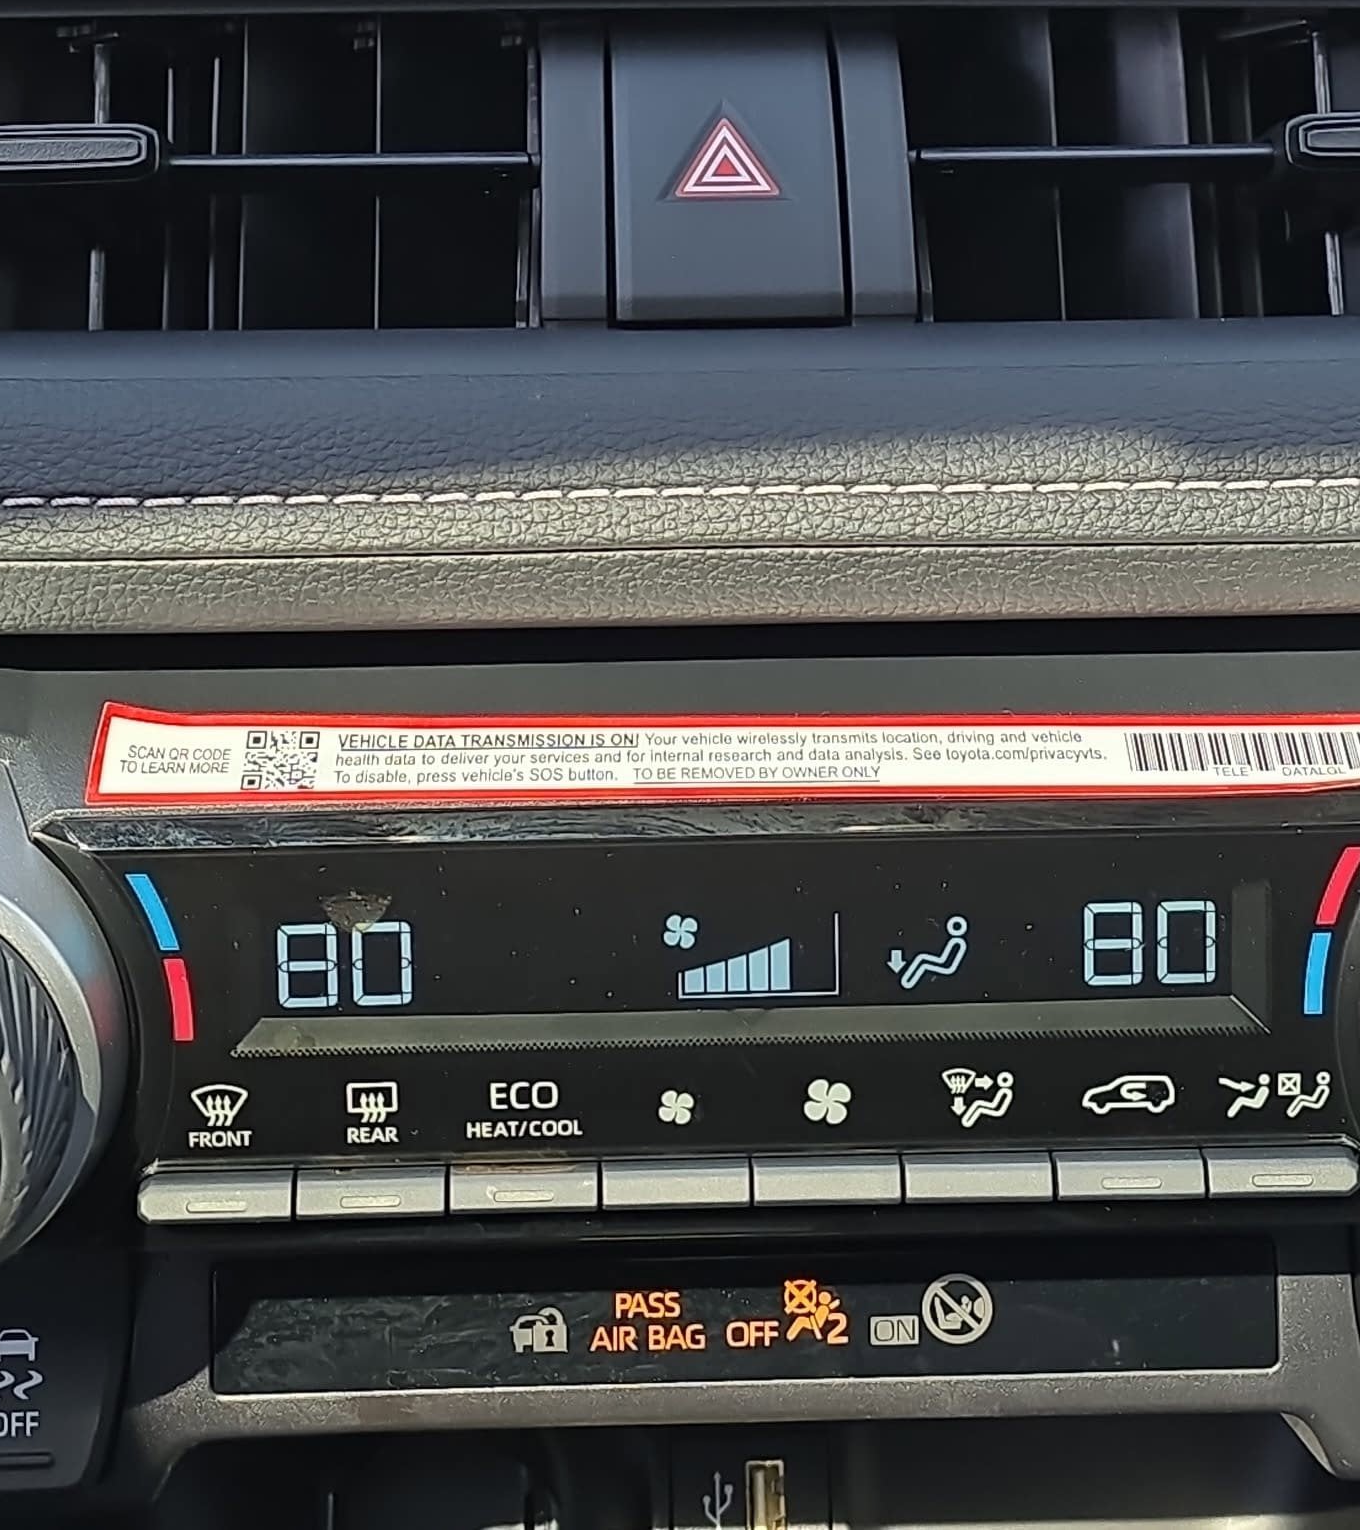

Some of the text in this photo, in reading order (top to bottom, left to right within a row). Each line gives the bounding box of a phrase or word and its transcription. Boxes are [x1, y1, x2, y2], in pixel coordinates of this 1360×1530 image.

[338, 734, 408, 749] VEHICLE
[414, 734, 456, 748] DATA
[461, 734, 586, 748] TRANSMISSION
[591, 734, 605, 747] IS
[645, 733, 677, 746] Your
[682, 732, 732, 745] vehicle
[737, 731, 807, 747] wirelessly
[812, 732, 878, 744] transmits
[882, 731, 942, 745] location,
[947, 730, 995, 746] driving
[1000, 730, 1027, 743] and
[1031, 730, 1082, 743] vehicle
[128, 744, 232, 761] SCAN QR CODE
[335, 753, 379, 766] health
[385, 753, 416, 766] data
[422, 753, 436, 765] to
[441, 752, 489, 765] deliver
[494, 753, 526, 768] your
[530, 751, 589, 764] services
[595, 750, 621, 763] and
[626, 750, 645, 763] for
[650, 749, 704, 763] internal
[709, 749, 771, 762] research
[777, 749, 804, 761] and
[809, 748, 840, 761] data
[845, 747, 908, 763] analysis.
[913, 747, 941, 760] See
[120, 760, 230, 774] TO LEARN MORE
[334, 765, 881, 786] To disable, press vehicle's SOS button. TO BE REMOVED BY OWNER ONLY
[1213, 765, 1250, 777] TELE
[1083, 900, 1216, 986] 80
[276, 920, 414, 1008] 80
[490, 1082, 560, 1111] ECO
[346, 1126, 399, 1145] REAR
[466, 1118, 584, 1139] HEAT/COOL
[188, 1130, 253, 1149] FRONT
[615, 1291, 681, 1319] PASS
[589, 1320, 779, 1352] AIR BAG OFF
[874, 1317, 916, 1343] ON
